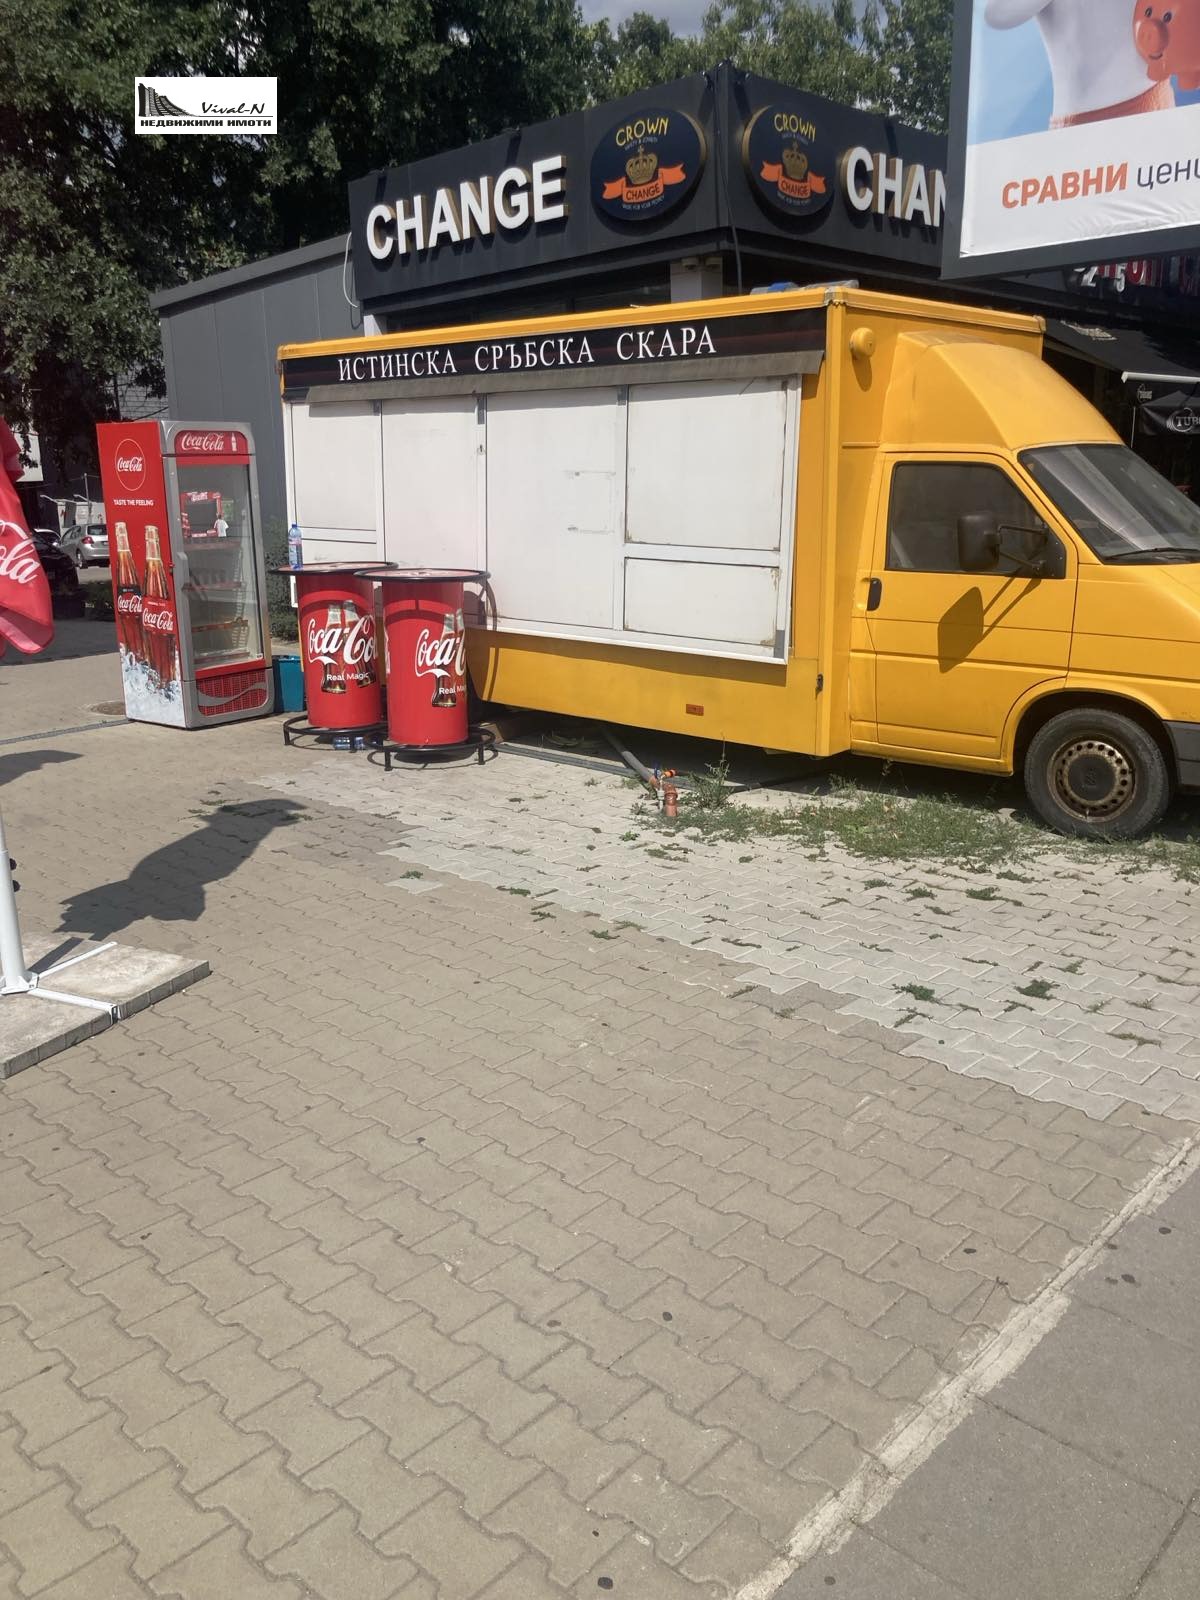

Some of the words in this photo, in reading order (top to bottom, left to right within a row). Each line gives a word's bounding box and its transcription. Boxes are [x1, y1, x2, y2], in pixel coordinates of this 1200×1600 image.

[616, 117, 668, 146] CROWN
[774, 113, 816, 142] CROWN
[626, 183, 660, 201] CHANGE
[780, 181, 809, 196] CHANGE
[1002, 162, 1127, 208] СРАВНИ
[366, 155, 567, 260] CHANGE
[338, 349, 458, 381] ИСТИНСКА
[474, 336, 595, 372] СРЪБСКА
[616, 325, 717, 361] СКАРА
[1175, 416, 1200, 427] TUB
[181, 432, 225, 451] Coca-Cola
[136, 499, 154, 507] FEELING
[327, 672, 345, 681] Real
[346, 672, 369, 682] Magic
[439, 686, 456, 695] Real
